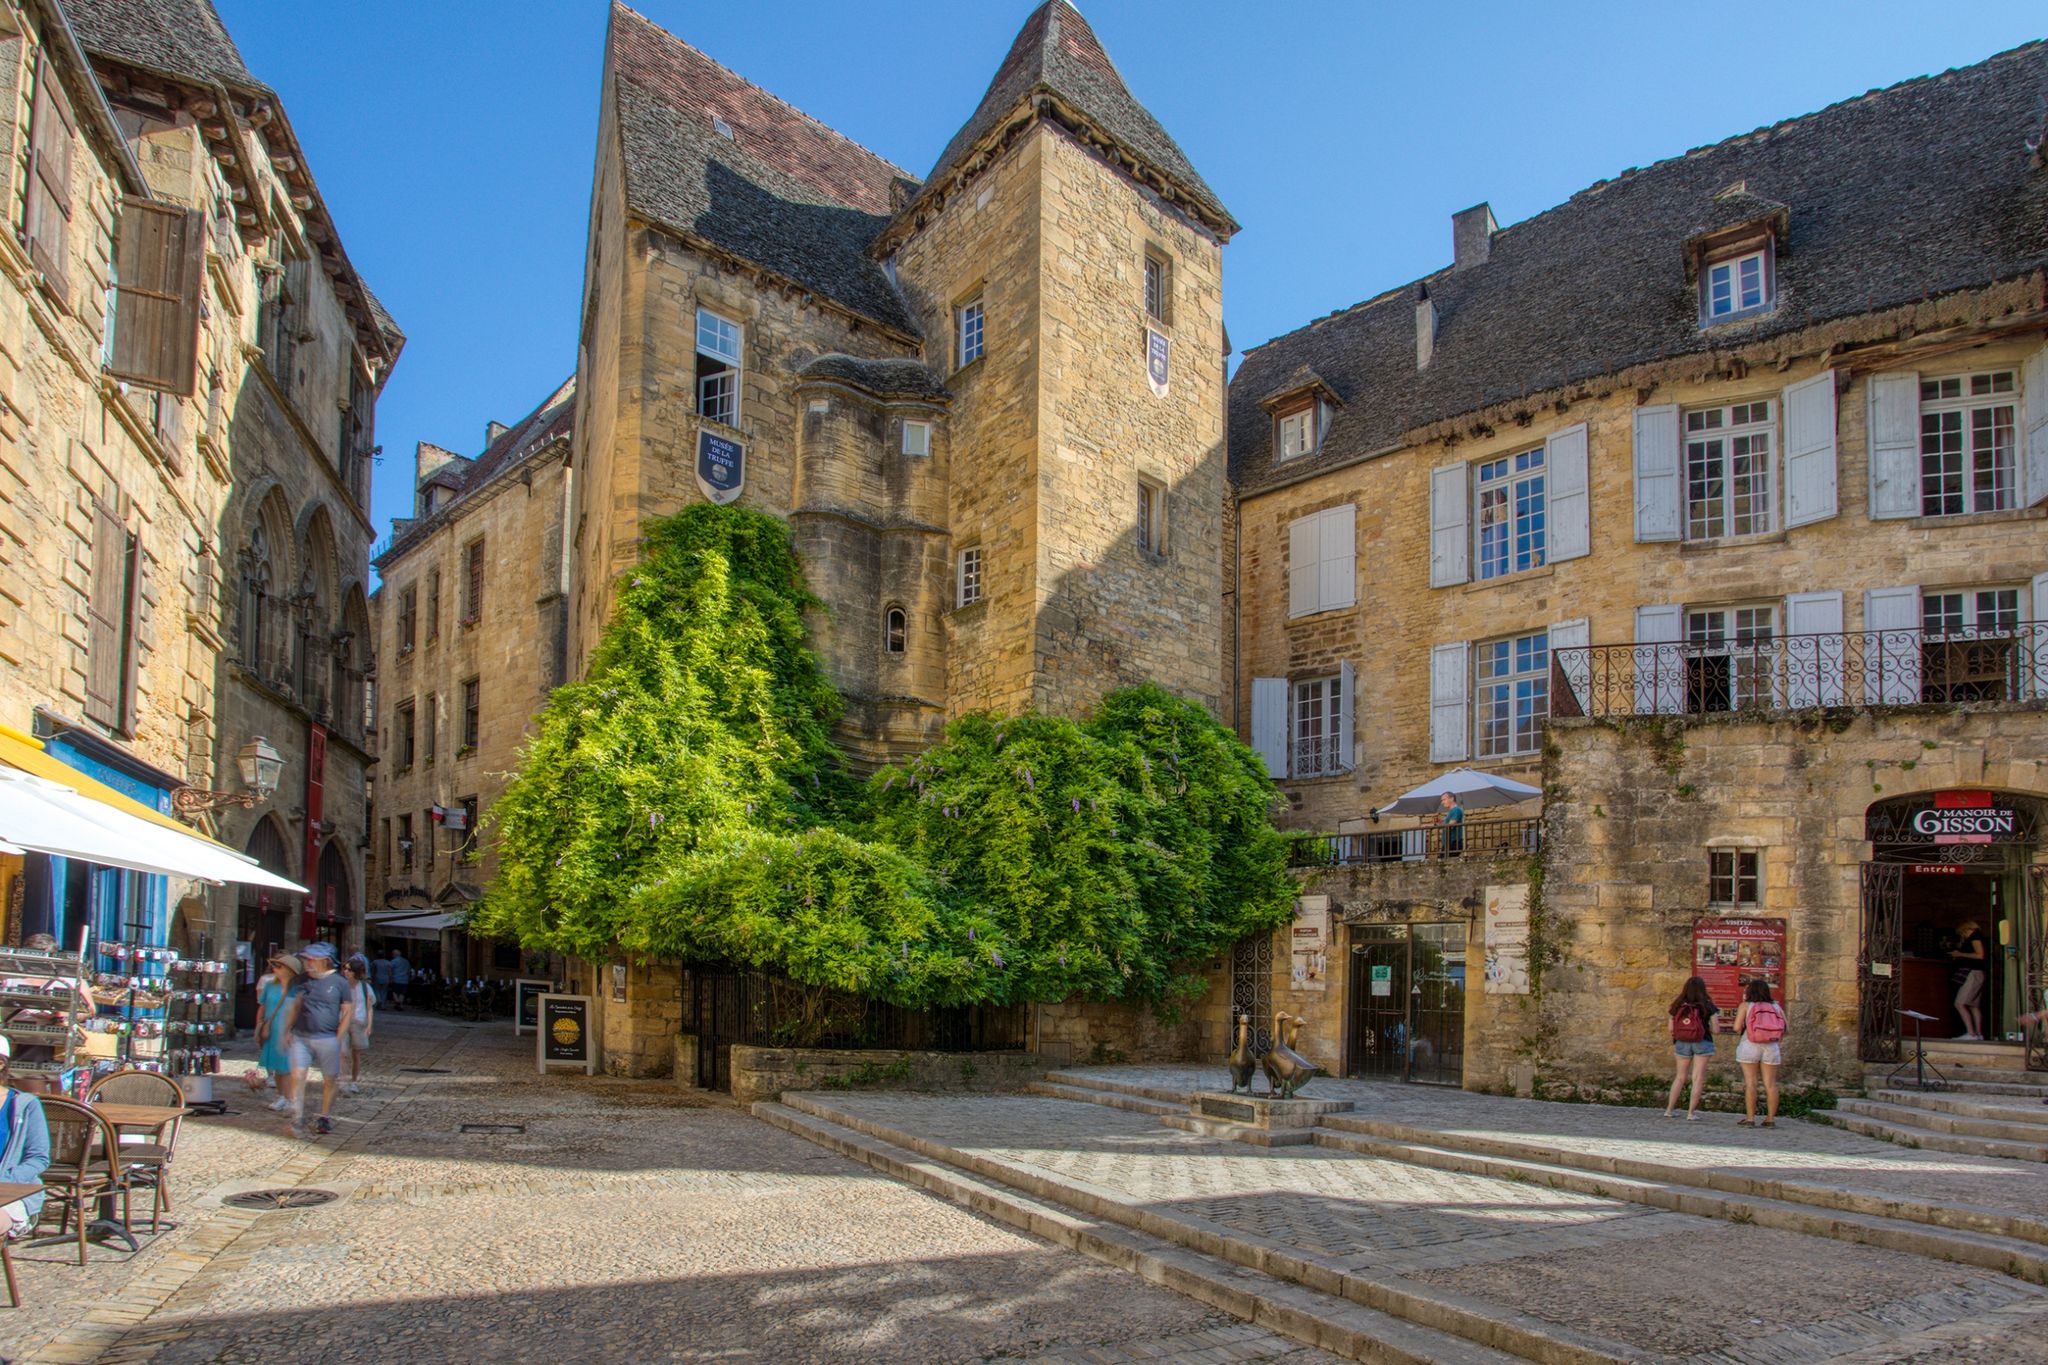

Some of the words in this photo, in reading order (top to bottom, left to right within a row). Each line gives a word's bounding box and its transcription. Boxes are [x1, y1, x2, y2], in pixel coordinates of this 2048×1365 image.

[709, 438, 733, 452] MUSÉE
[712, 446, 721, 455] DE
[707, 453, 734, 468] TRUFFE
[1944, 809, 1997, 817] MANOIR
[1914, 809, 2014, 834] GISSON
[1739, 926, 1776, 936] GISSON
